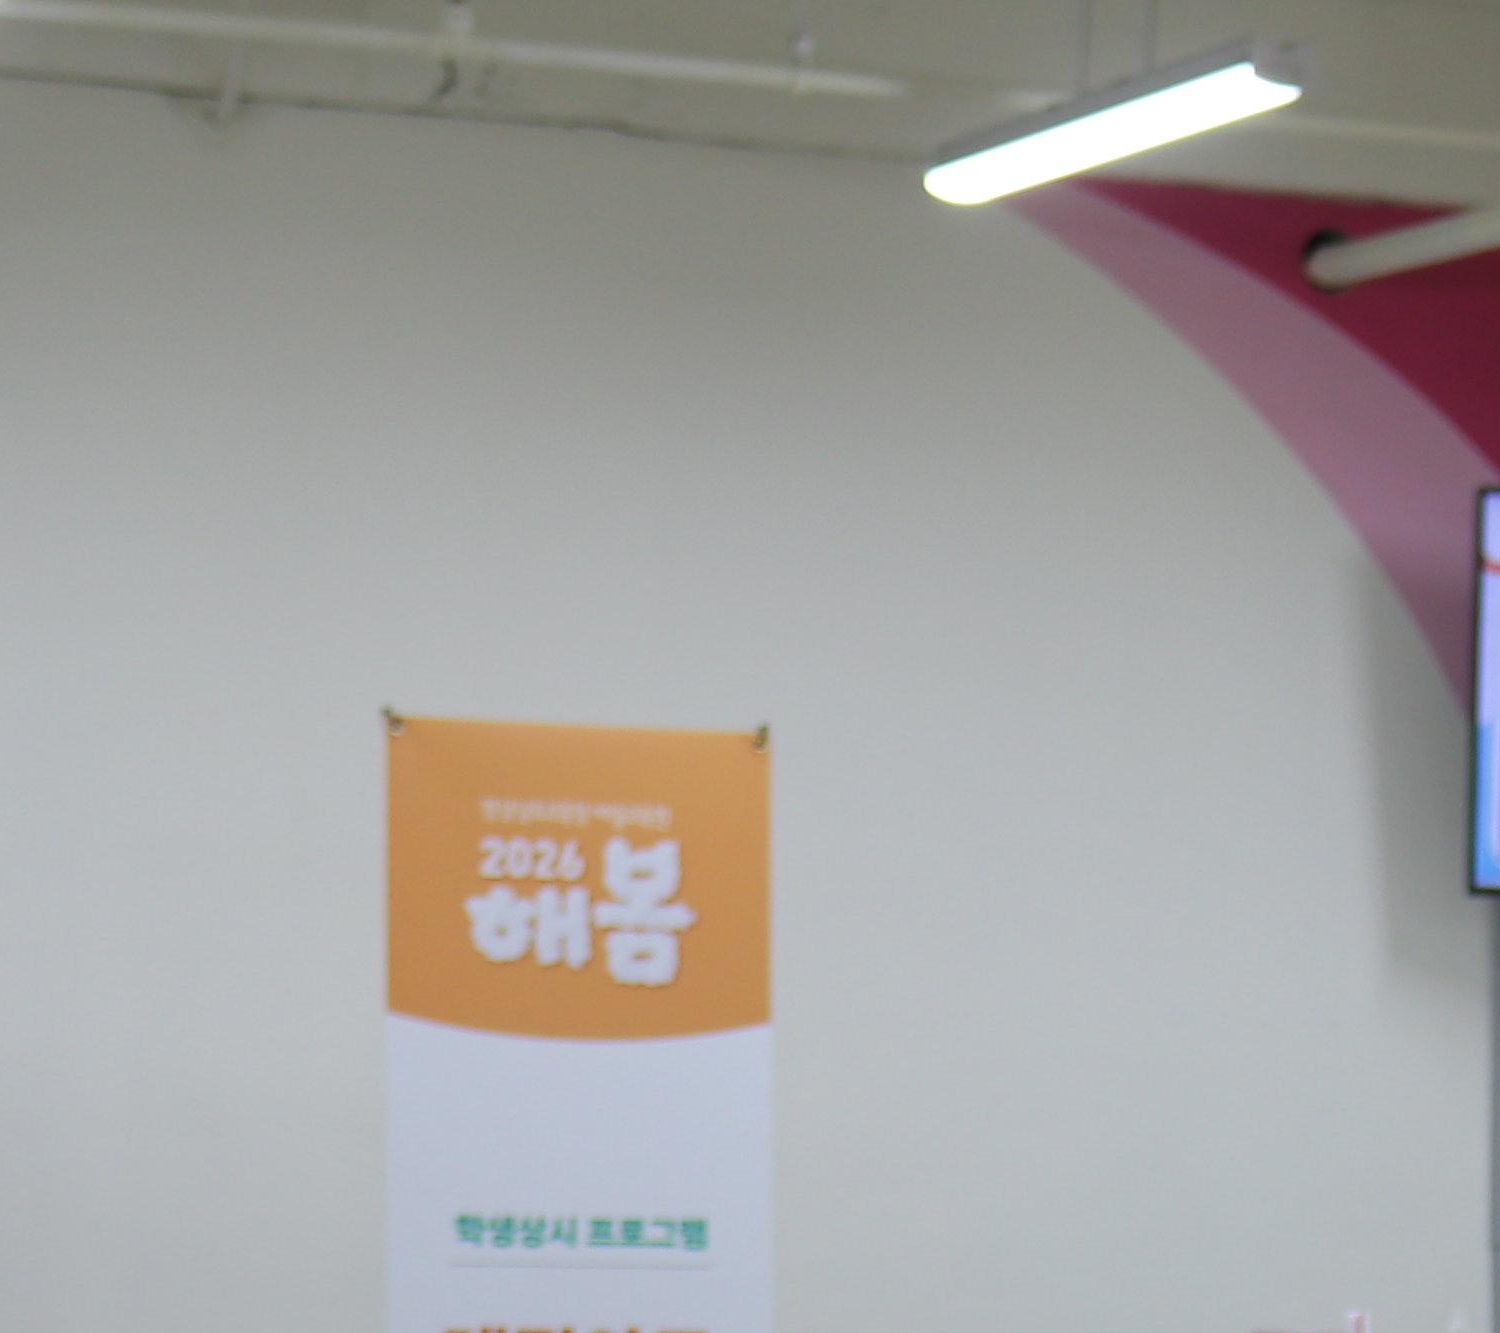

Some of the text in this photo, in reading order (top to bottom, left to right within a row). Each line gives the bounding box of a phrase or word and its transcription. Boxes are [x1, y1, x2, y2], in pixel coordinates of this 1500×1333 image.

[479, 836, 586, 882] 2026
[463, 836, 697, 988] 해봄
[454, 1213, 709, 1251] 학생상시 프로그램
